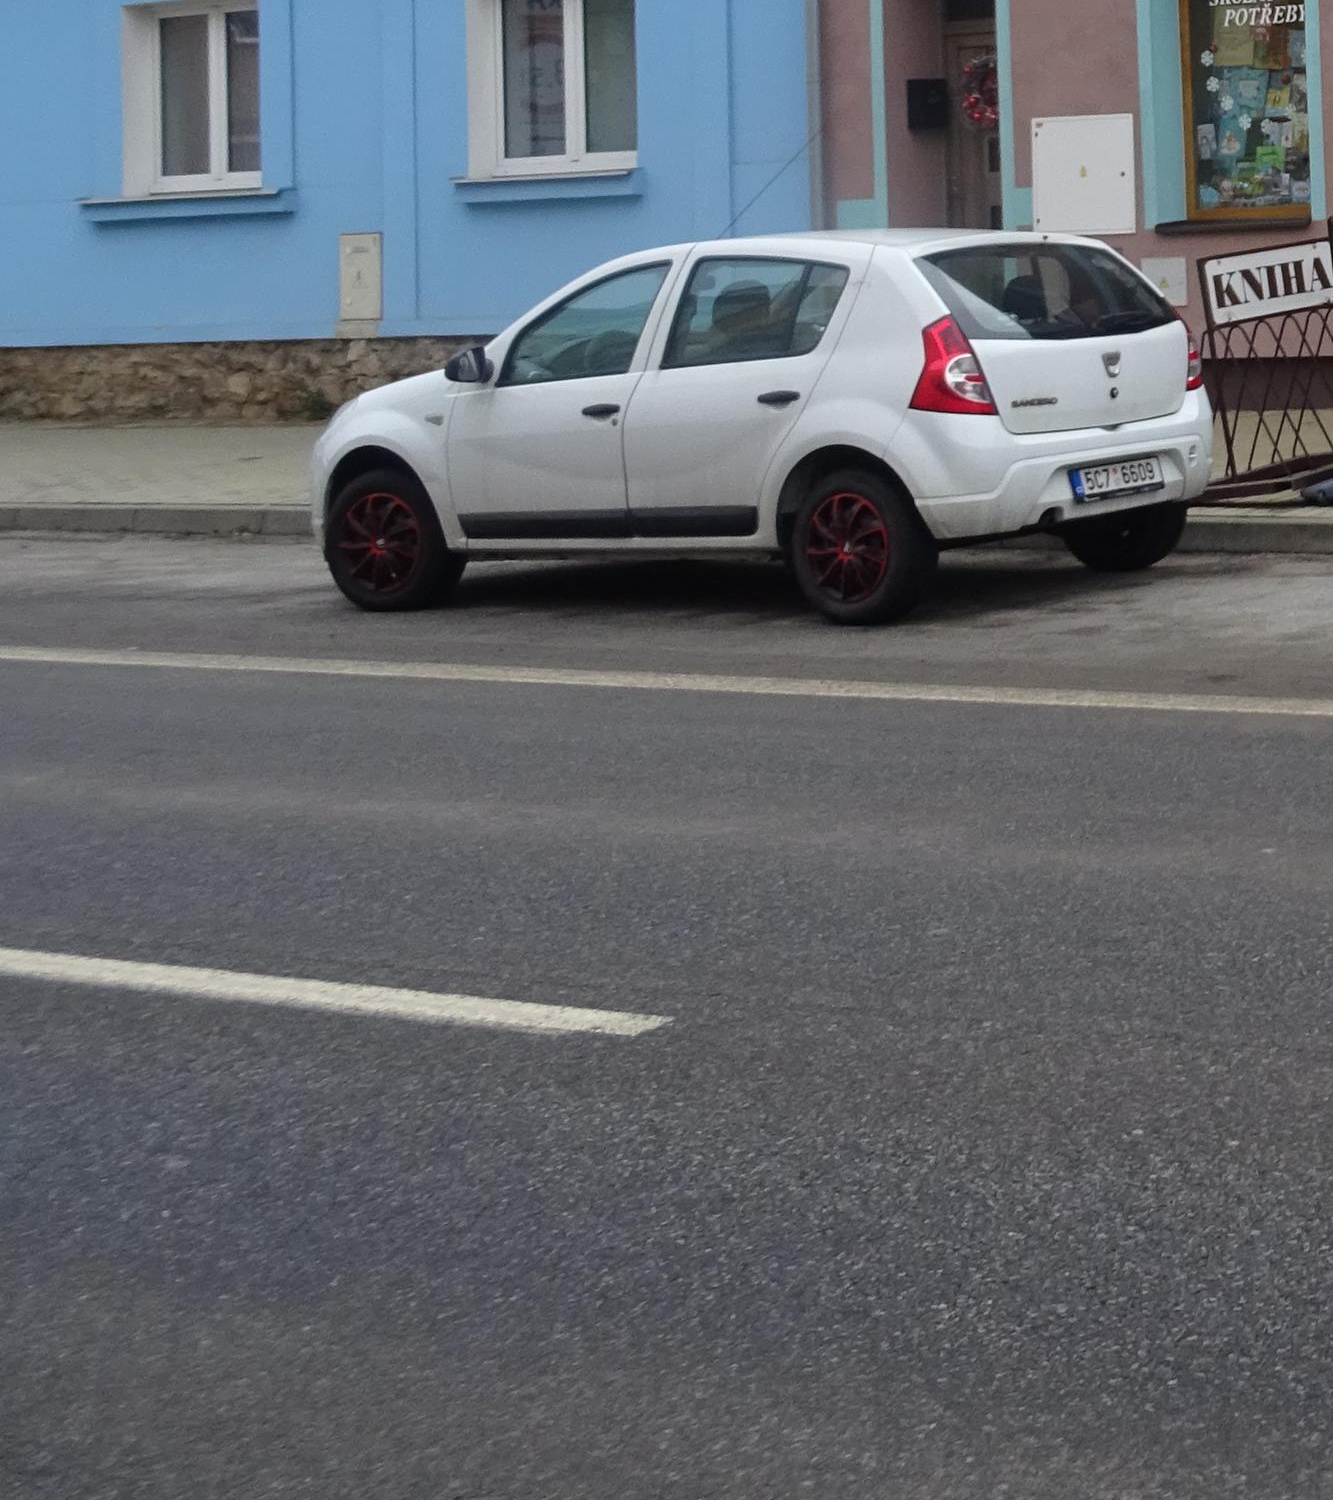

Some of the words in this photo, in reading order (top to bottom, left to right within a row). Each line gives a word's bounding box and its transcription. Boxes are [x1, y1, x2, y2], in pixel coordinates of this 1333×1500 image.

[1212, 257, 1333, 309] KNIHA
[1084, 468, 1110, 490] 5C7
[1121, 462, 1155, 484] 6609
